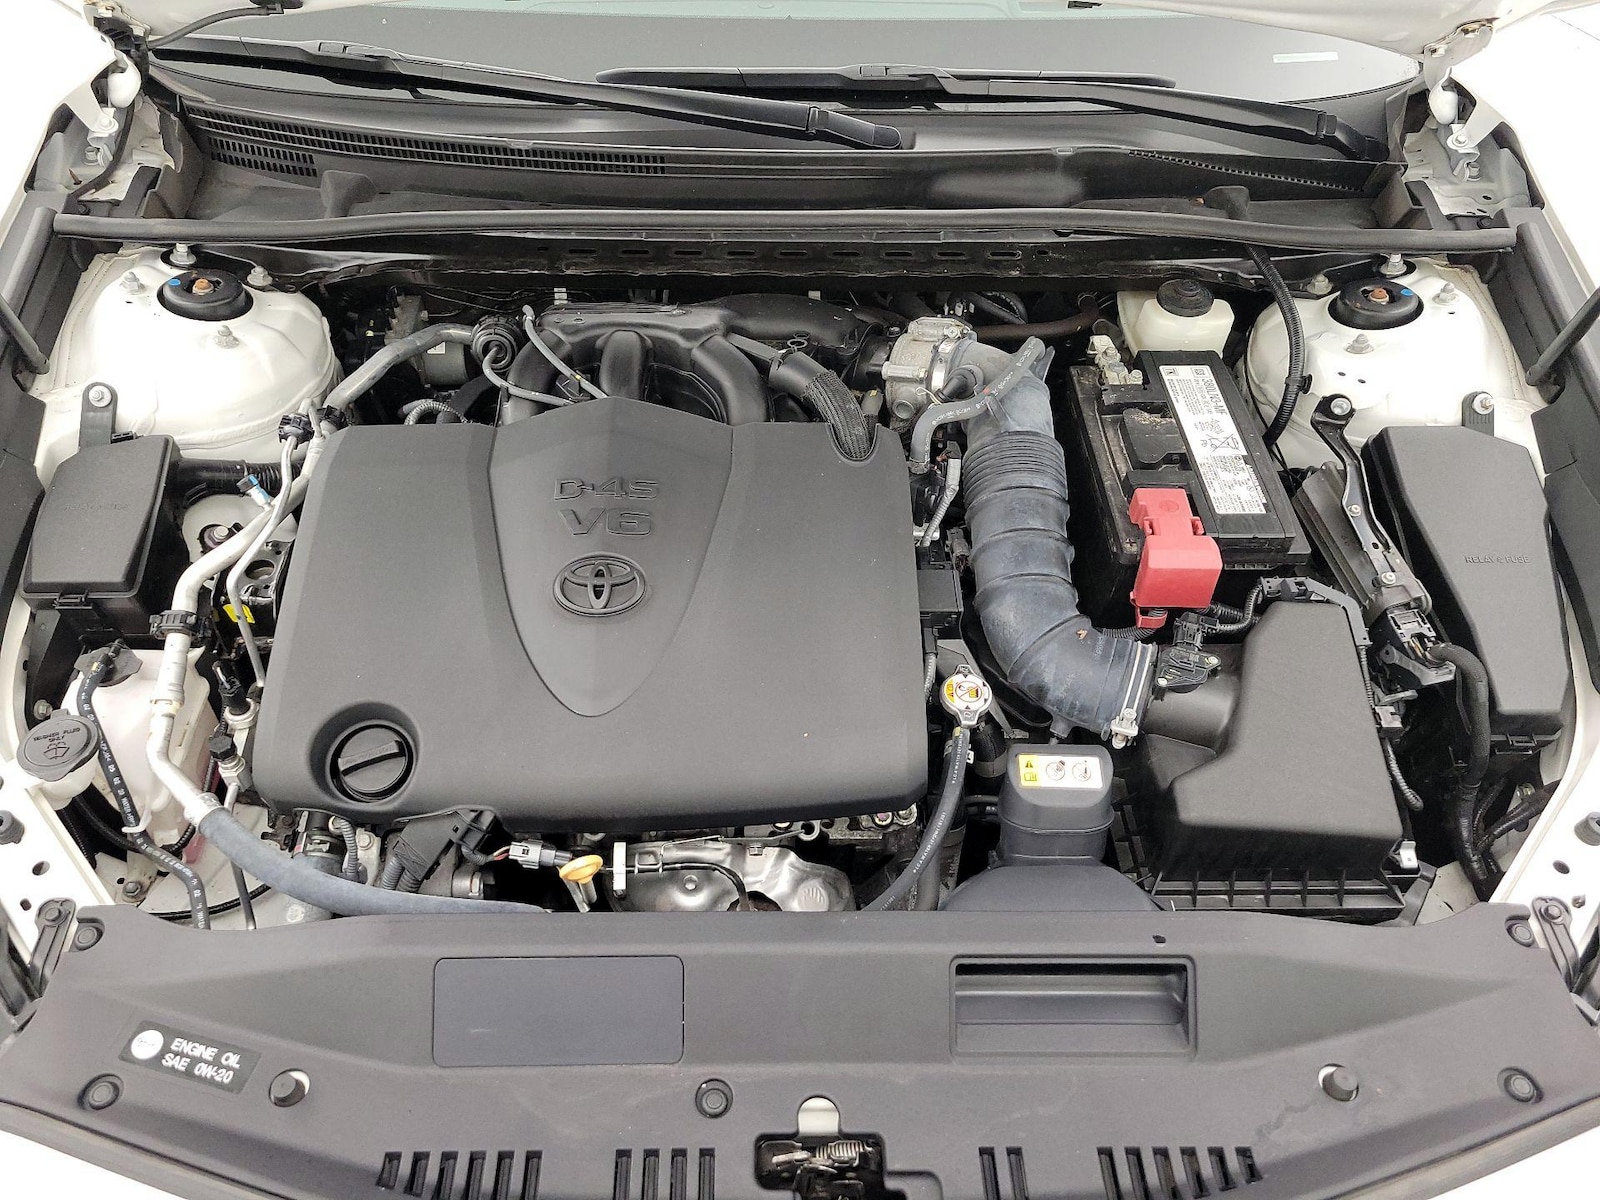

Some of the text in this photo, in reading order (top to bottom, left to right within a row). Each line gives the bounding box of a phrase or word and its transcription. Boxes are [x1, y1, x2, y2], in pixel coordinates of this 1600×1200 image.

[554, 477, 659, 500] D-4S
[559, 507, 652, 536] V6
[161, 1052, 191, 1072] SAE
[170, 1037, 241, 1069] ENGINE OIL
